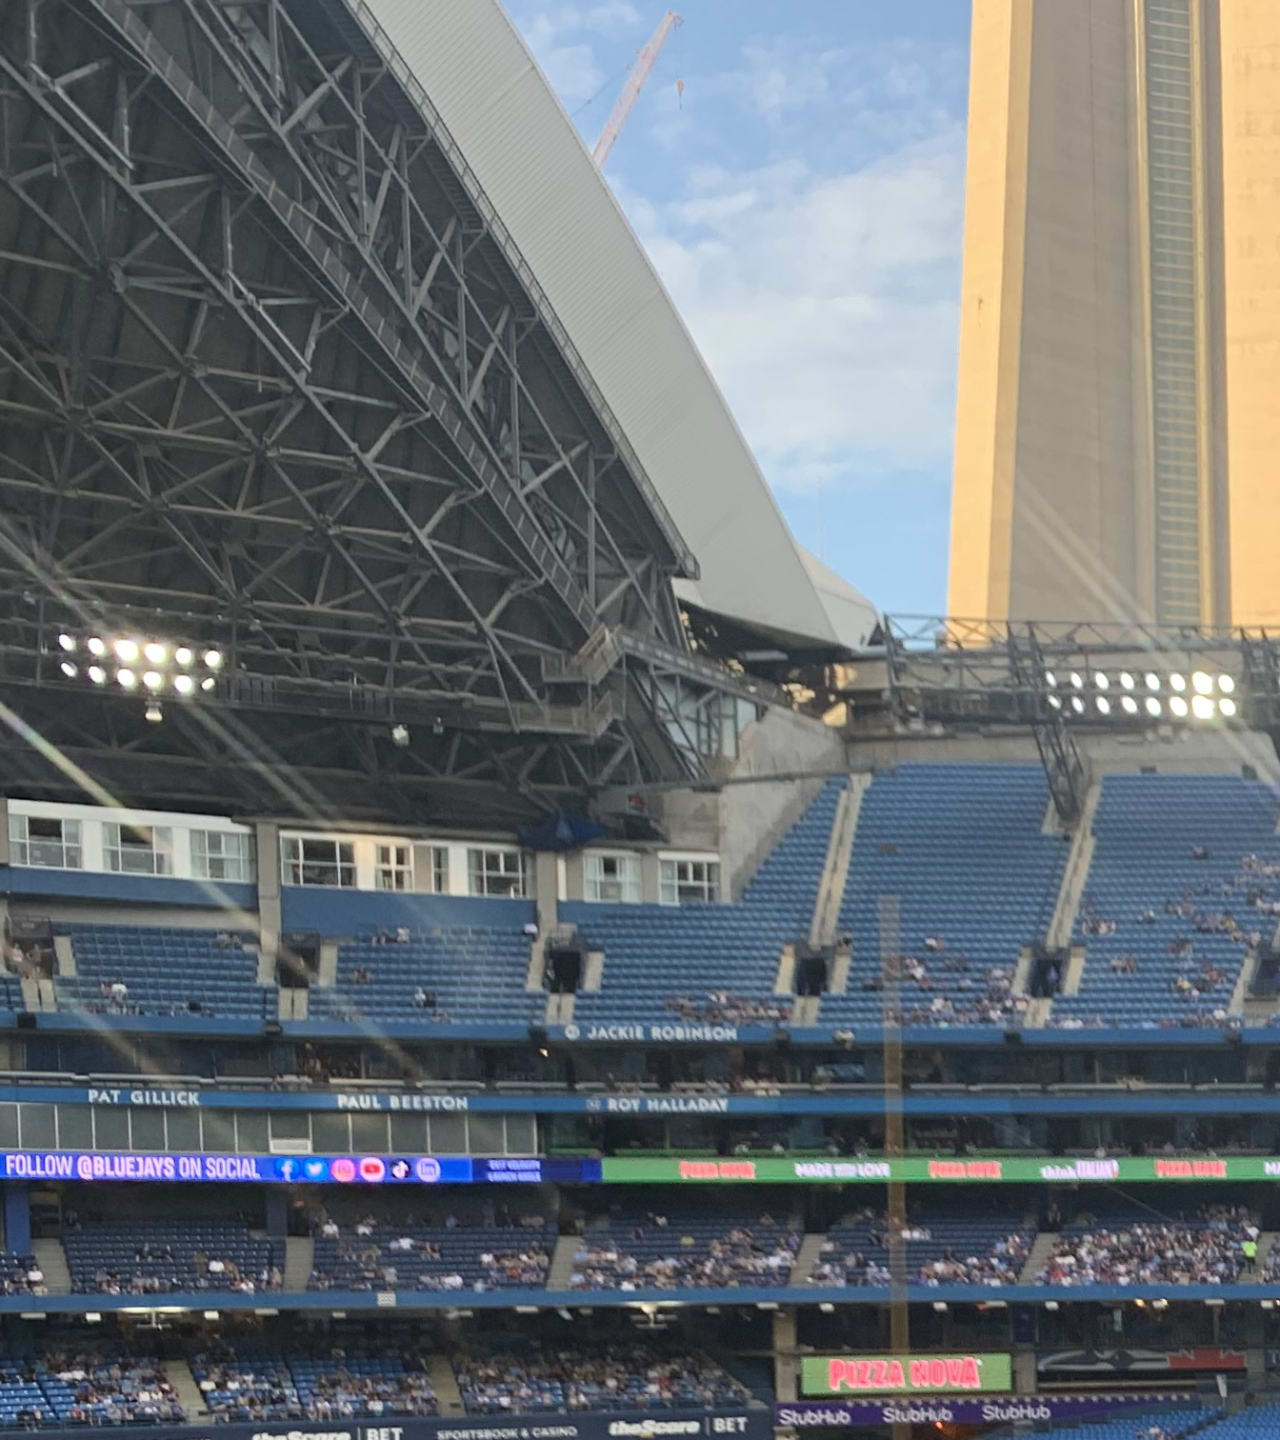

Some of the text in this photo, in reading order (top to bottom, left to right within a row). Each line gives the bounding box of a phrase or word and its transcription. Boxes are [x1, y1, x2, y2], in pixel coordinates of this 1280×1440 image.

[588, 1026, 738, 1041] JACKIE ROBINSON
[88, 1089, 200, 1105] PAT GILLICK
[338, 1095, 468, 1110] PAUL BEESTON
[608, 1098, 729, 1112] ROY HALLADAY
[5, 1155, 260, 1181] FOLLOW @BLUEJAYS ON SOCIAL
[828, 1357, 979, 1391] PIZZA NOVA
[779, 1407, 851, 1425] StubHub
[883, 1406, 953, 1423] StubHub
[982, 1403, 1051, 1421] StubHub
[437, 1428, 519, 1440] SPORTSBOOK
[532, 1426, 579, 1438] CASINO
[608, 1417, 747, 1436] theScore BET
